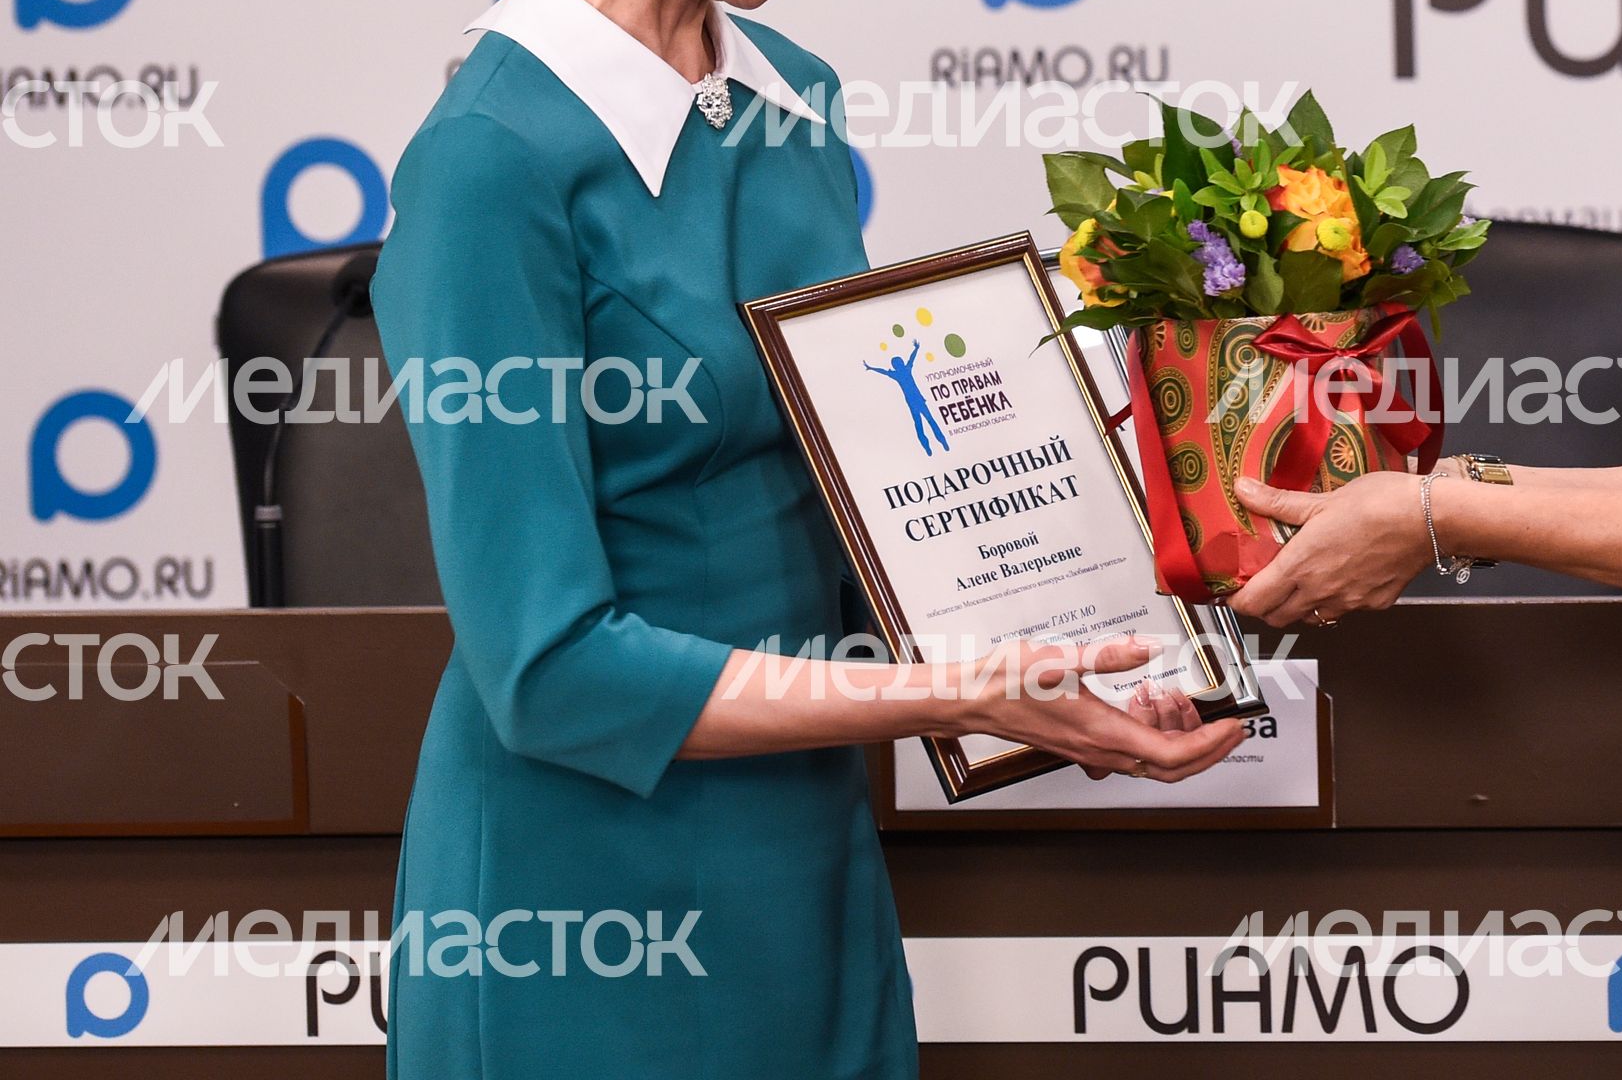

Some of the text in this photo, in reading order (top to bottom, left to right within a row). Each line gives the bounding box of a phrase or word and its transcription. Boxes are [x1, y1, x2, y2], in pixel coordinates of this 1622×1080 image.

[925, 357, 994, 382] УПОЛНОМОЧЕННЫЙ
[930, 370, 1003, 402] ПО ПРАВАМ
[938, 390, 1012, 426] РЕБЁНКА
[882, 435, 1074, 510] ПОДАРОЧНЫЙ
[904, 474, 1081, 542] СЕРТИФИКАТ
[977, 531, 1040, 561] Боровой
[955, 545, 1084, 592] Алене Валерьевне
[1051, 611, 1078, 628] ГАУК
[1079, 604, 1097, 619] МО
[1089, 605, 1149, 633] музыкальный
[1072, 945, 1470, 1035] РИАМО
